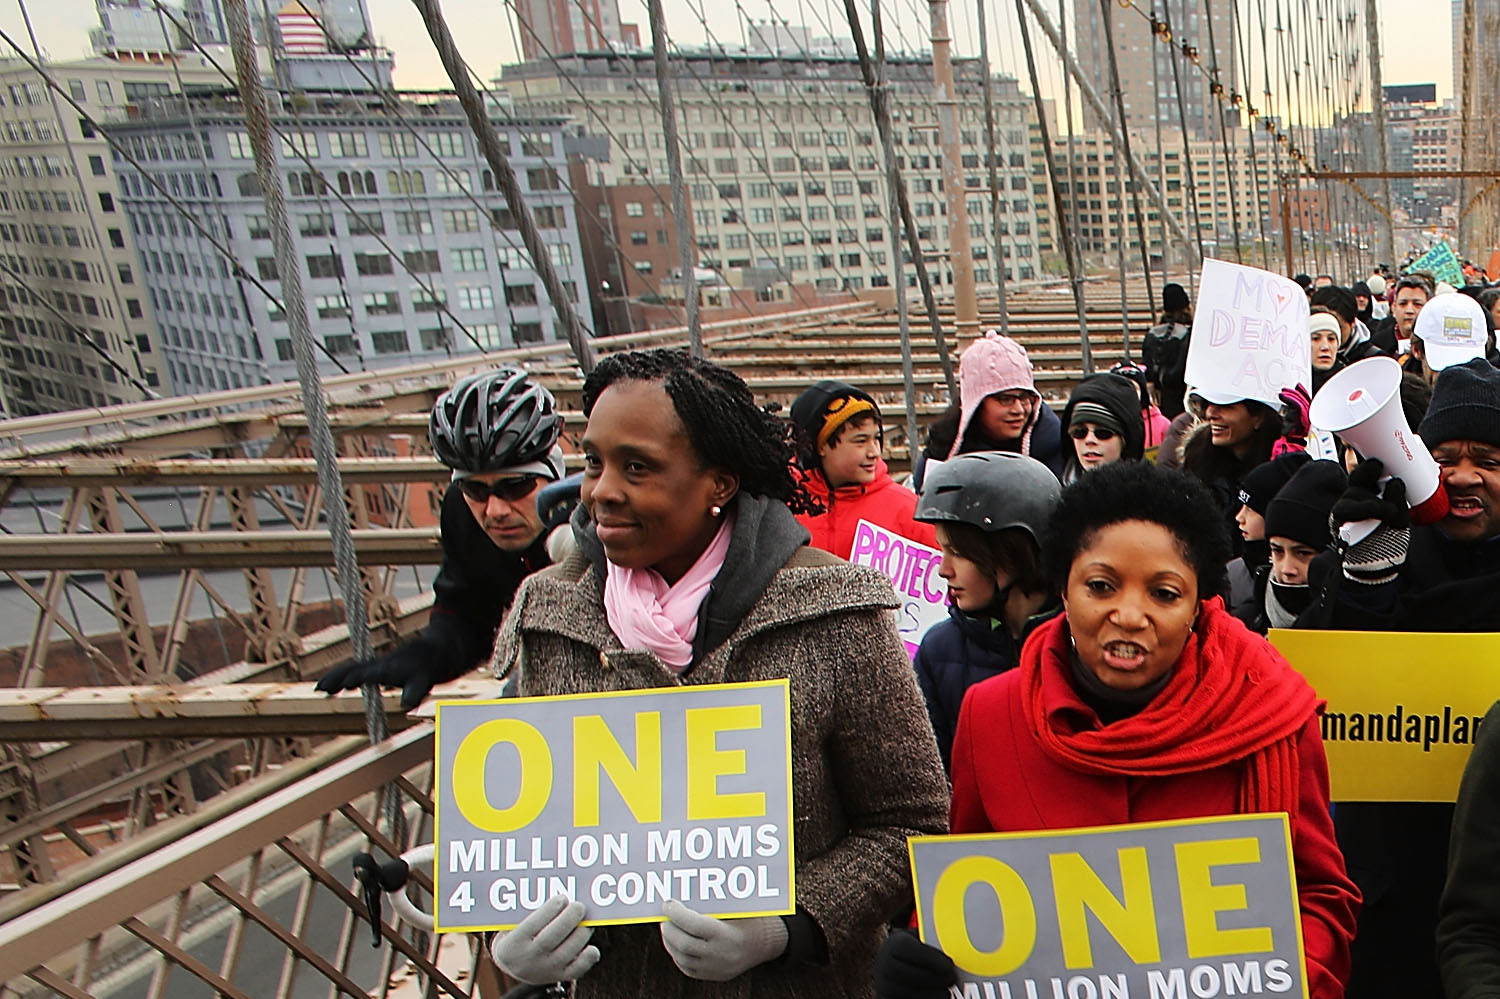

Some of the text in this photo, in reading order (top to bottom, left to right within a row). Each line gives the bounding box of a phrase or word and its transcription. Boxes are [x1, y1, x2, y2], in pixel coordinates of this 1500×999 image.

[1209, 308, 1309, 369] DEMA
[853, 523, 952, 607] PROTEC
[451, 704, 766, 833] ONE
[448, 823, 781, 873] MILLION MOMS
[448, 864, 780, 914] 4 GUN CONTROL
[933, 837, 1275, 978] ONE
